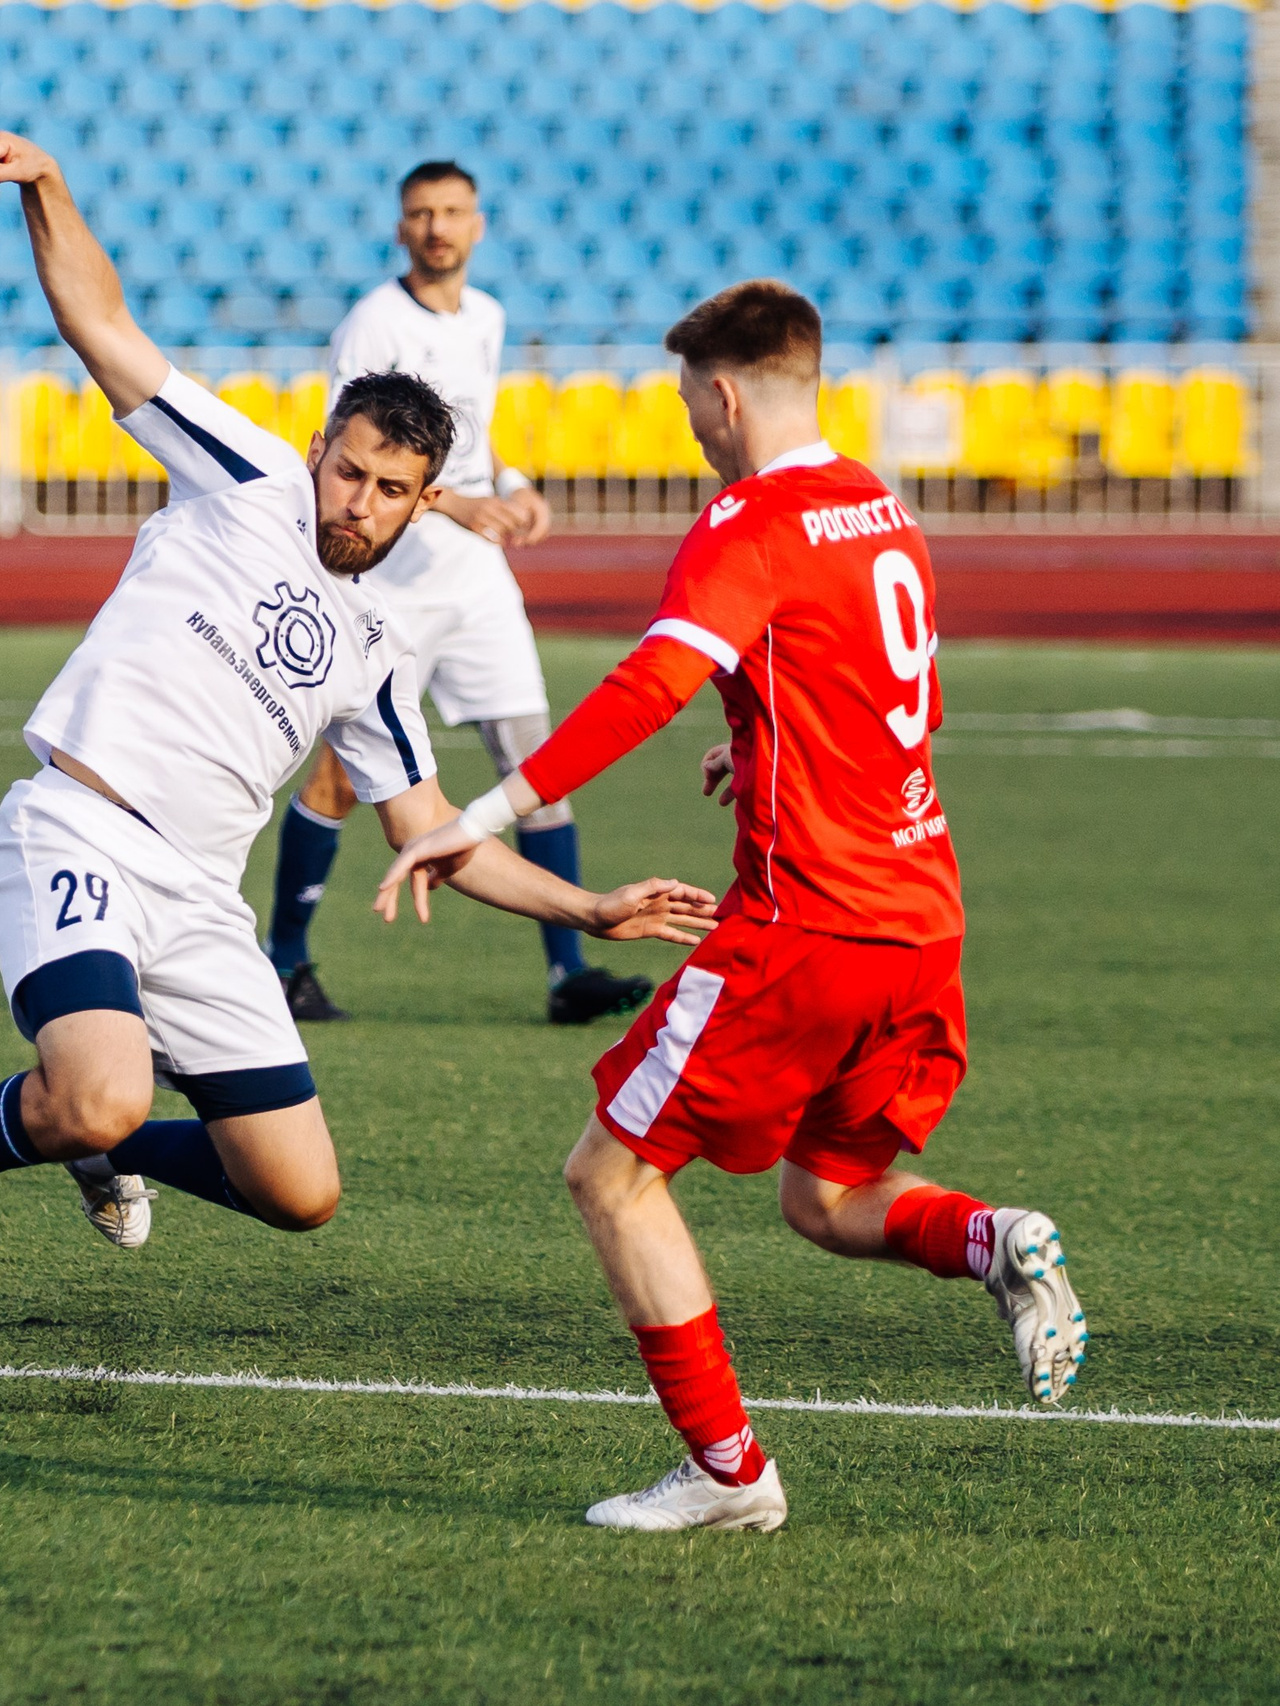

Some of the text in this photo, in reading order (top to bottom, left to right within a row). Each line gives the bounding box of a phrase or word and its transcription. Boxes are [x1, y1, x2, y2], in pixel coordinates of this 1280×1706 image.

[801, 495, 918, 546] РОСГОССТ
[873, 549, 930, 749] 9
[185, 610, 301, 760] КубаньЭнергоРемон
[891, 820, 926, 848] МОЙ
[50, 869, 109, 931] 29
